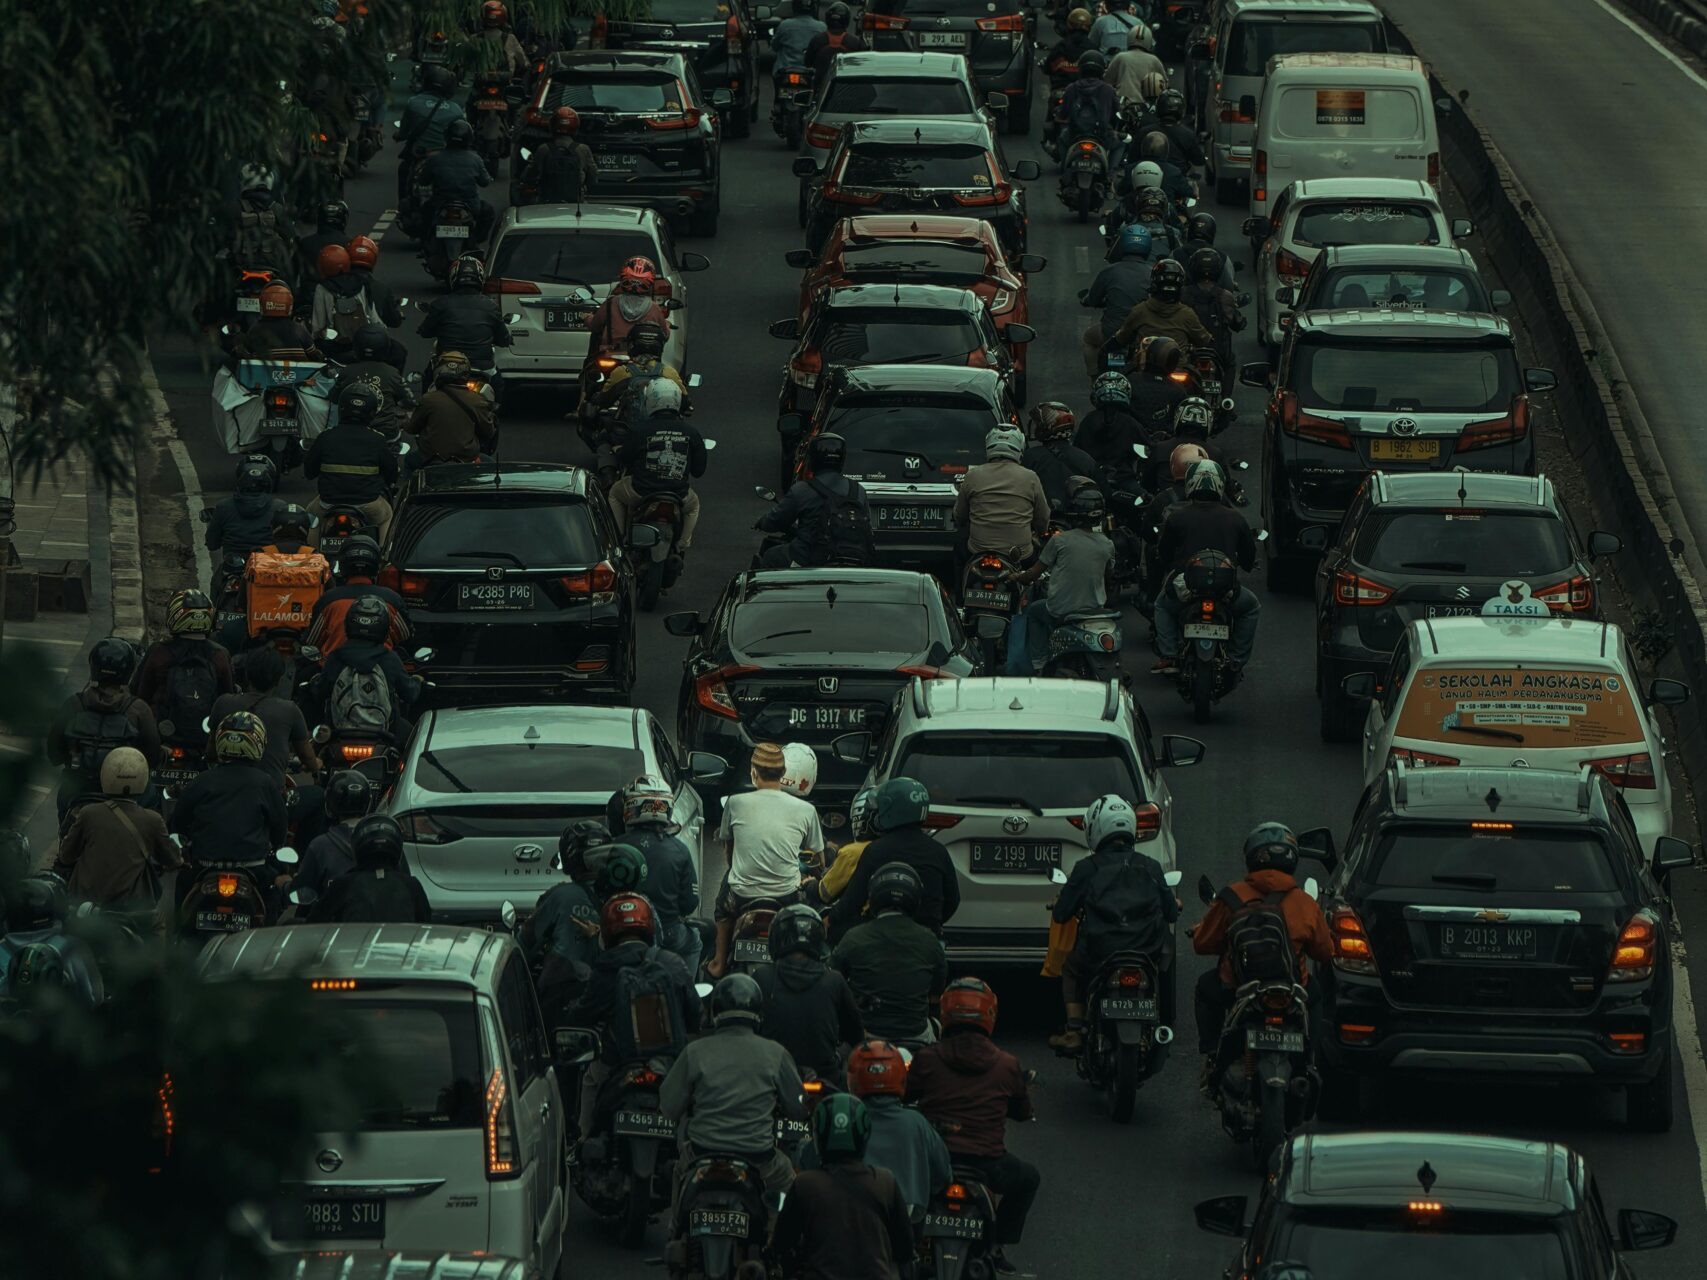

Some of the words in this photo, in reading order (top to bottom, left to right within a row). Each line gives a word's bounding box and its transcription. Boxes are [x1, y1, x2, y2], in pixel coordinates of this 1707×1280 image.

[1376, 300, 1423, 310] Silverbird
[548, 311, 554, 322] B
[1373, 441, 1380, 453] B
[1389, 440, 1412, 453] 1962
[1418, 441, 1438, 454] SUB
[880, 508, 887, 521] B
[893, 508, 918, 521] 2035
[923, 508, 943, 521] KML
[462, 585, 469, 599] B
[478, 585, 505, 599] 2385
[1493, 605, 1539, 615] TAKSI
[1439, 674, 1512, 689] SEKOLAH
[1521, 674, 1603, 690] ANGKASA
[737, 695, 767, 703] CIVIC
[1440, 689, 1476, 700] LANUD
[1480, 689, 1510, 700] HALIM
[1514, 689, 1602, 701] PERDANAKUSUMA
[816, 708, 841, 723] 1317
[973, 845, 981, 861] B
[993, 845, 1026, 862] 2199
[1034, 845, 1059, 863] UKE
[1446, 927, 1454, 944] B
[1463, 927, 1498, 944] 2013
[1507, 927, 1533, 945] KKP
[737, 941, 743, 952] B
[619, 1113, 625, 1123] B
[777, 1120, 784, 1131] B
[787, 1120, 810, 1132] 3054
[352, 1203, 381, 1223] STU
[702, 1211, 727, 1224] 3855
[728, 1213, 746, 1226] FZN
[934, 1215, 961, 1228] 4932
